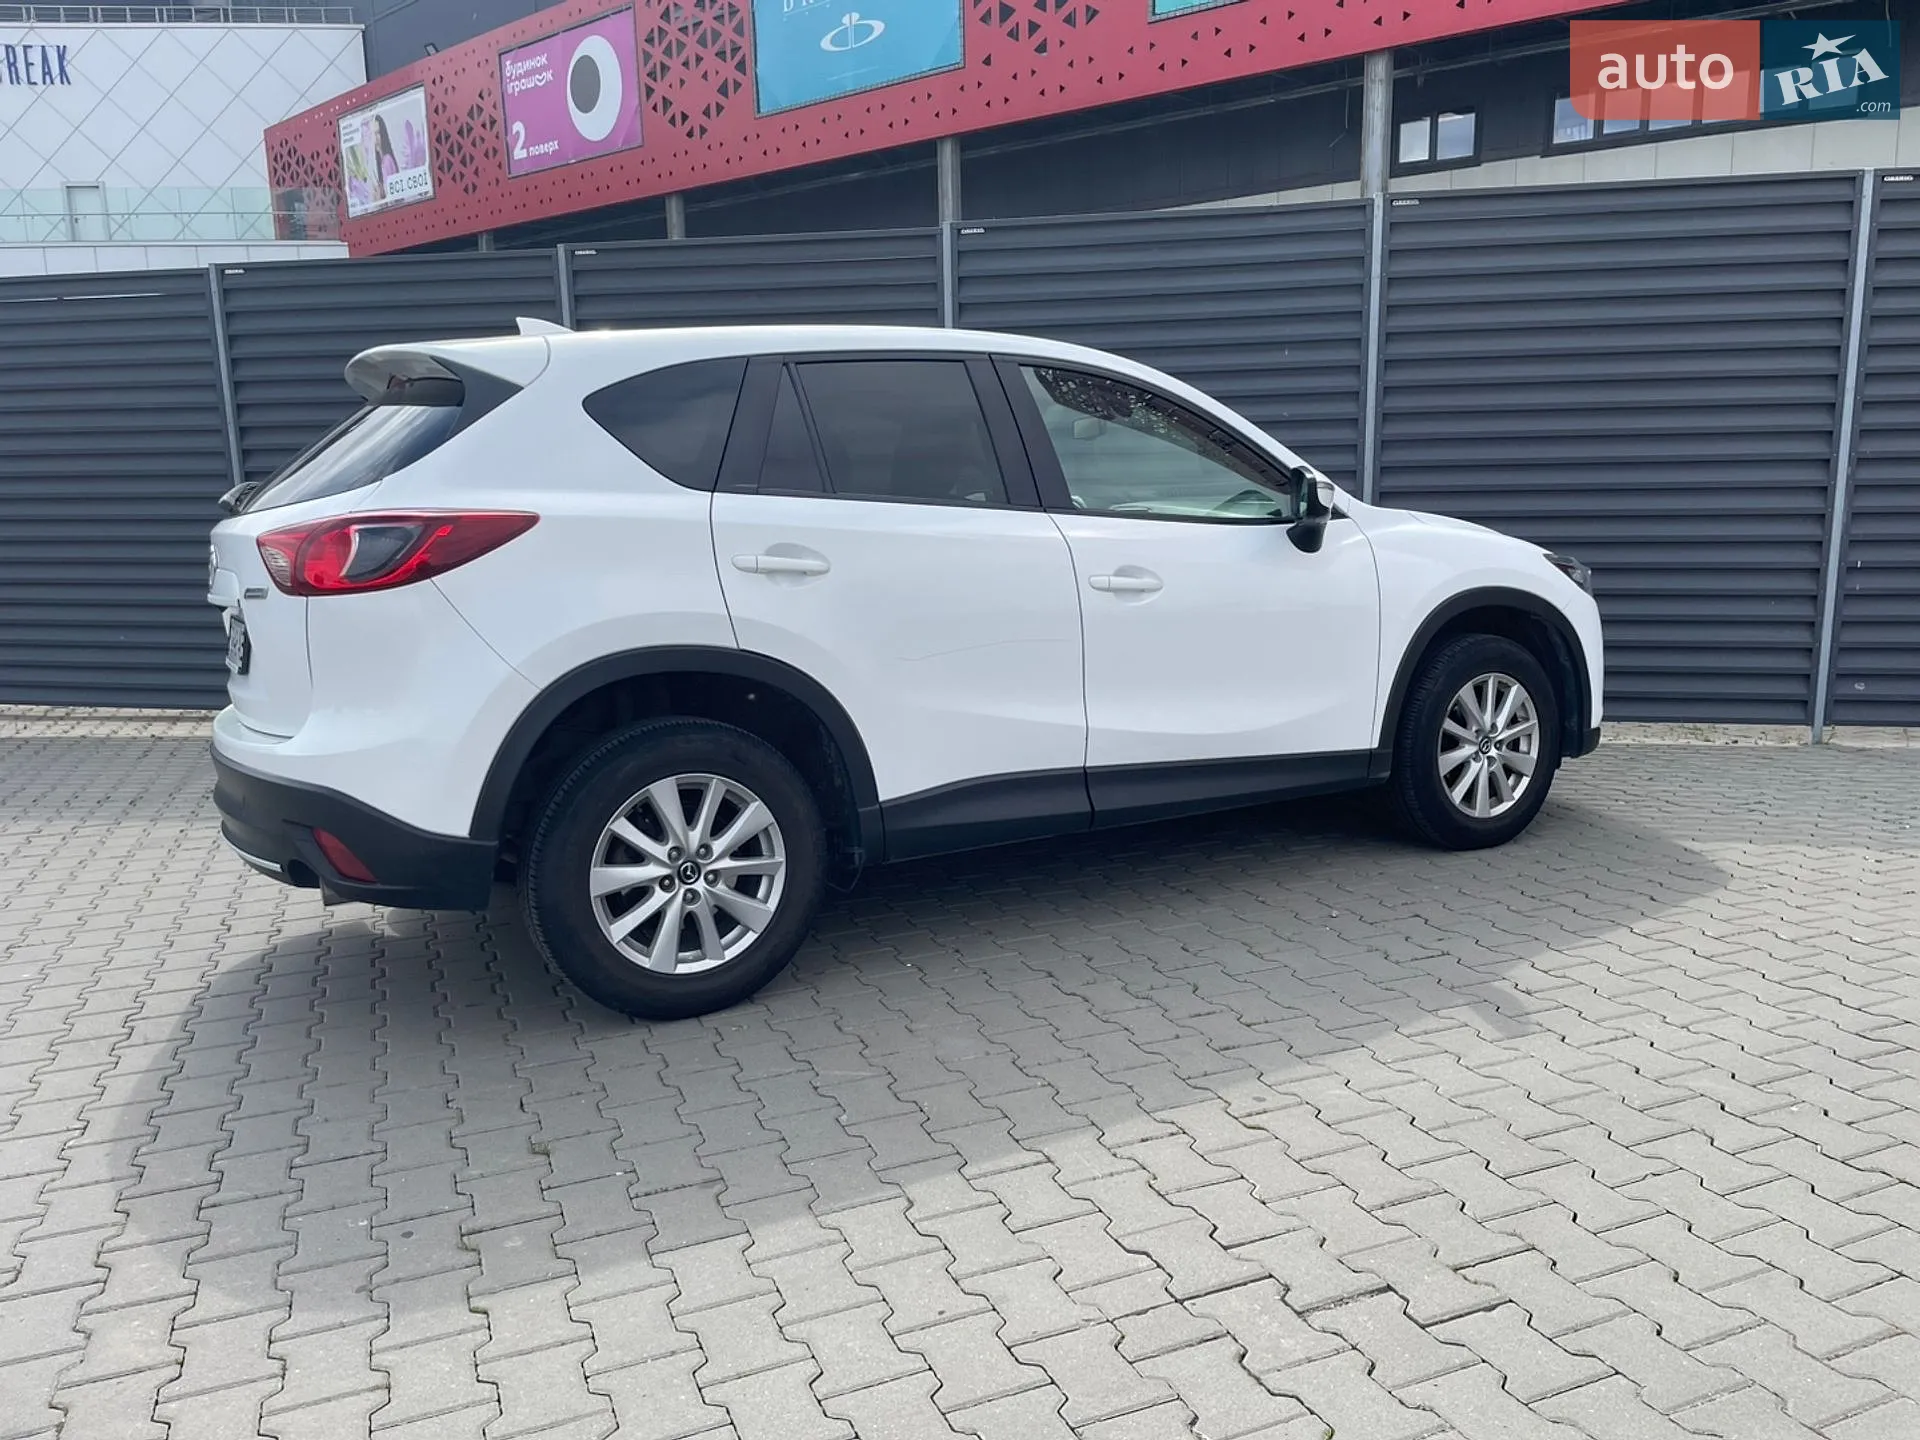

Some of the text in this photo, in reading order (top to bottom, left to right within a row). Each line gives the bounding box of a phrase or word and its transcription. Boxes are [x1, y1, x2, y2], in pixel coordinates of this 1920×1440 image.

[0, 44, 72, 86] REAK
[512, 120, 560, 160] 2 поверх
